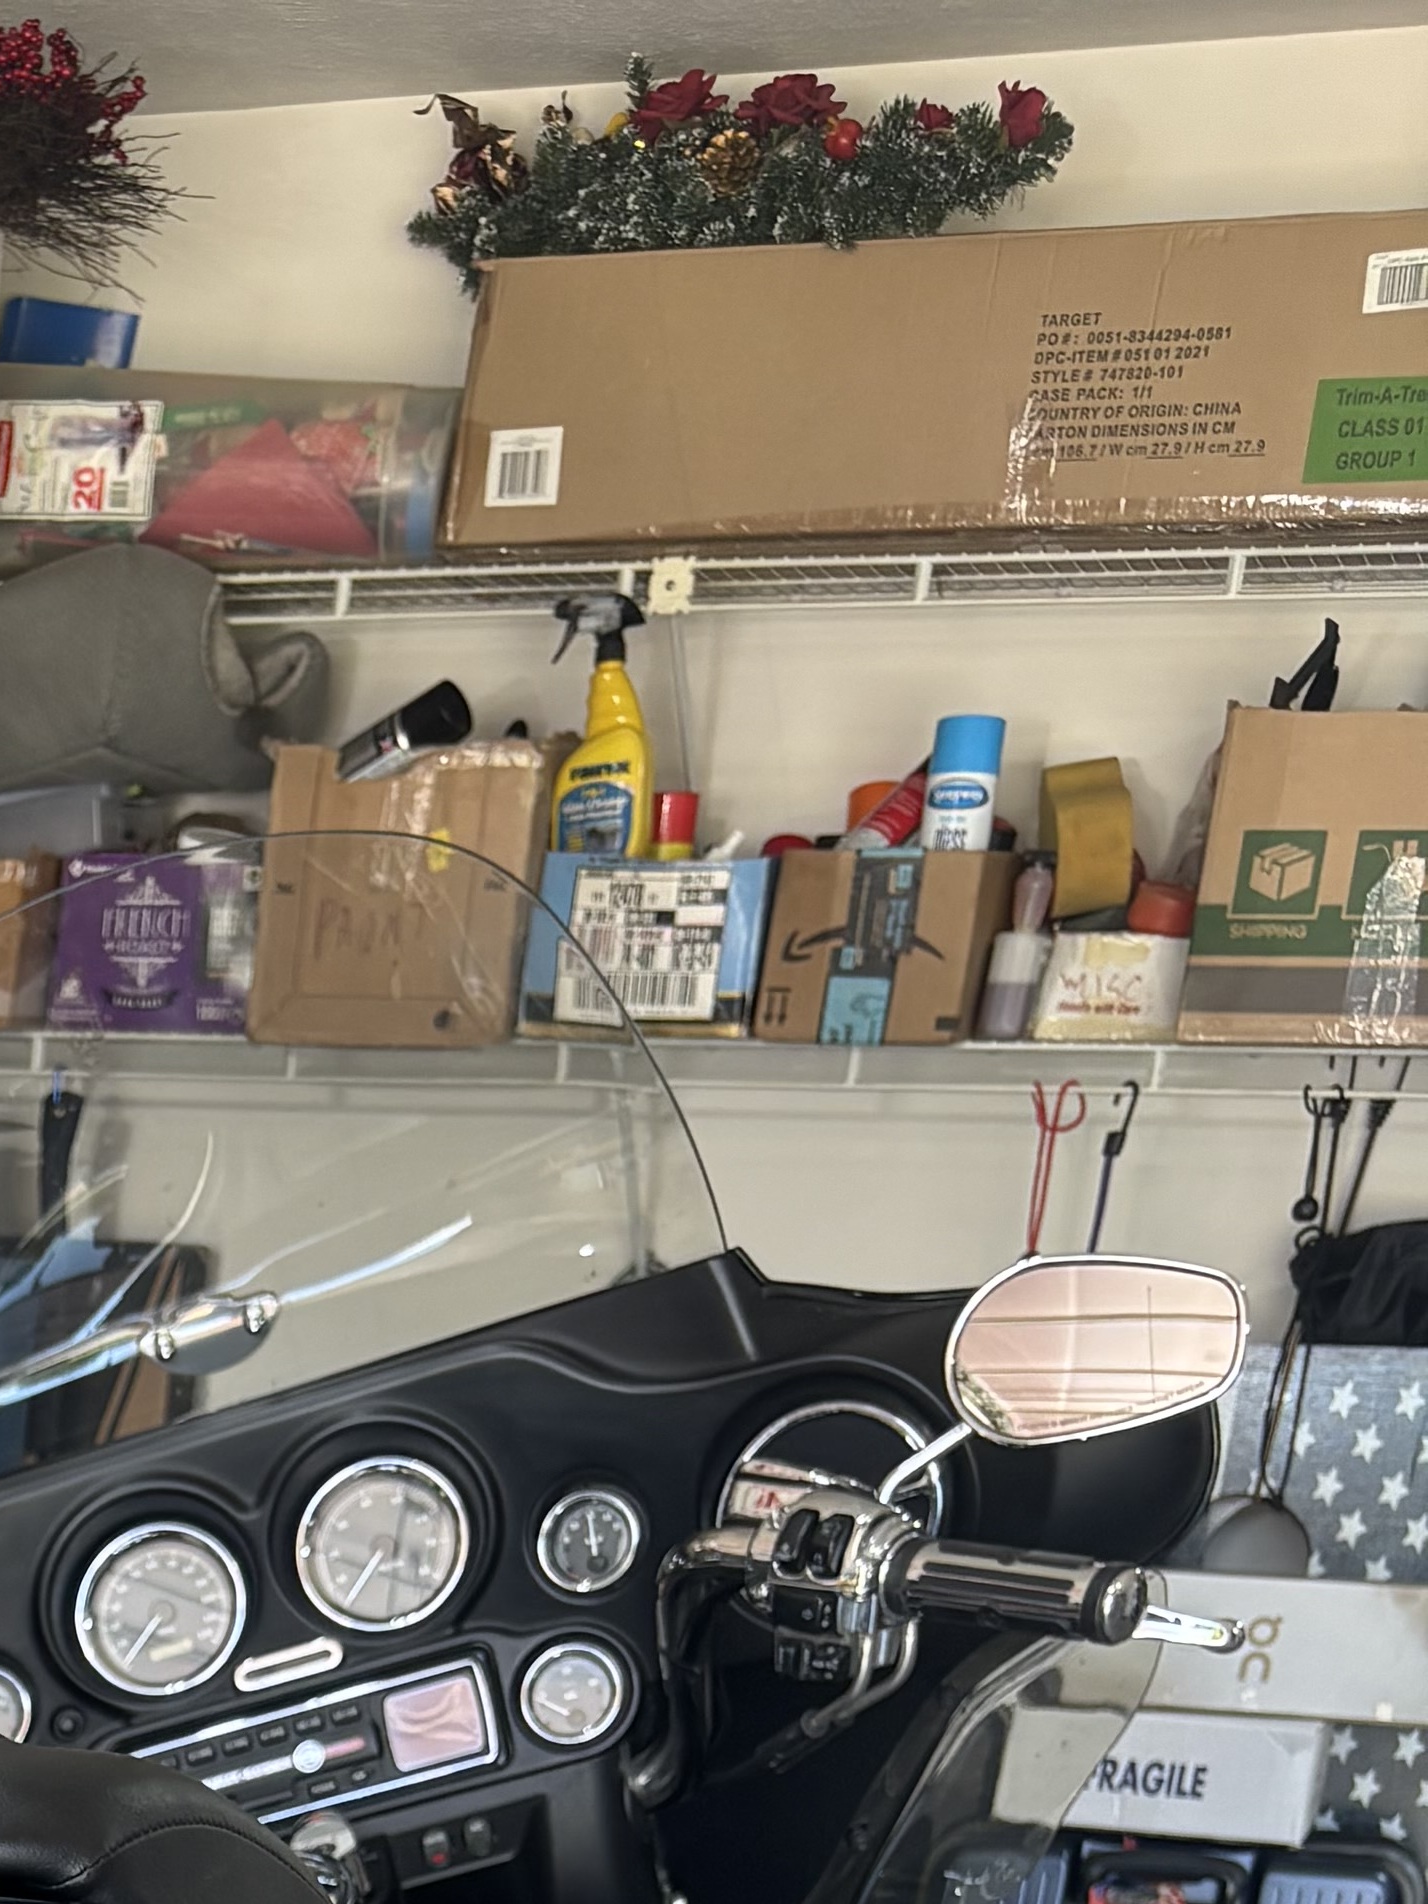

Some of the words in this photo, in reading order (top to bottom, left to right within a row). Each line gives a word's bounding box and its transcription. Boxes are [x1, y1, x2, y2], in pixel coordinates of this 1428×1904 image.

[1040, 312, 1102, 327] TARGET
[1034, 349, 1110, 365] DPC-ITEM
[1175, 345, 1210, 359] 2021
[1031, 368, 1084, 384] STYLE
[1029, 388, 1070, 402] CASE
[1076, 386, 1124, 400] PACK:
[1132, 385, 1153, 399] 1/1
[1335, 384, 1428, 406] Trim-A-Tre
[1103, 405, 1126, 419] OF
[1128, 404, 1189, 418] ORIGIN:
[1193, 401, 1242, 416] CHINA
[1091, 422, 1189, 437] DIMENSIONS
[1192, 421, 1208, 435] IN
[1211, 420, 1236, 434] CM
[1337, 418, 1399, 438] CLASS
[1404, 416, 1424, 435] 01
[1234, 439, 1266, 453] 27.9
[1335, 450, 1402, 470] GROUP
[1406, 447, 1416, 466] 1
[69, 466, 101, 511] 20
